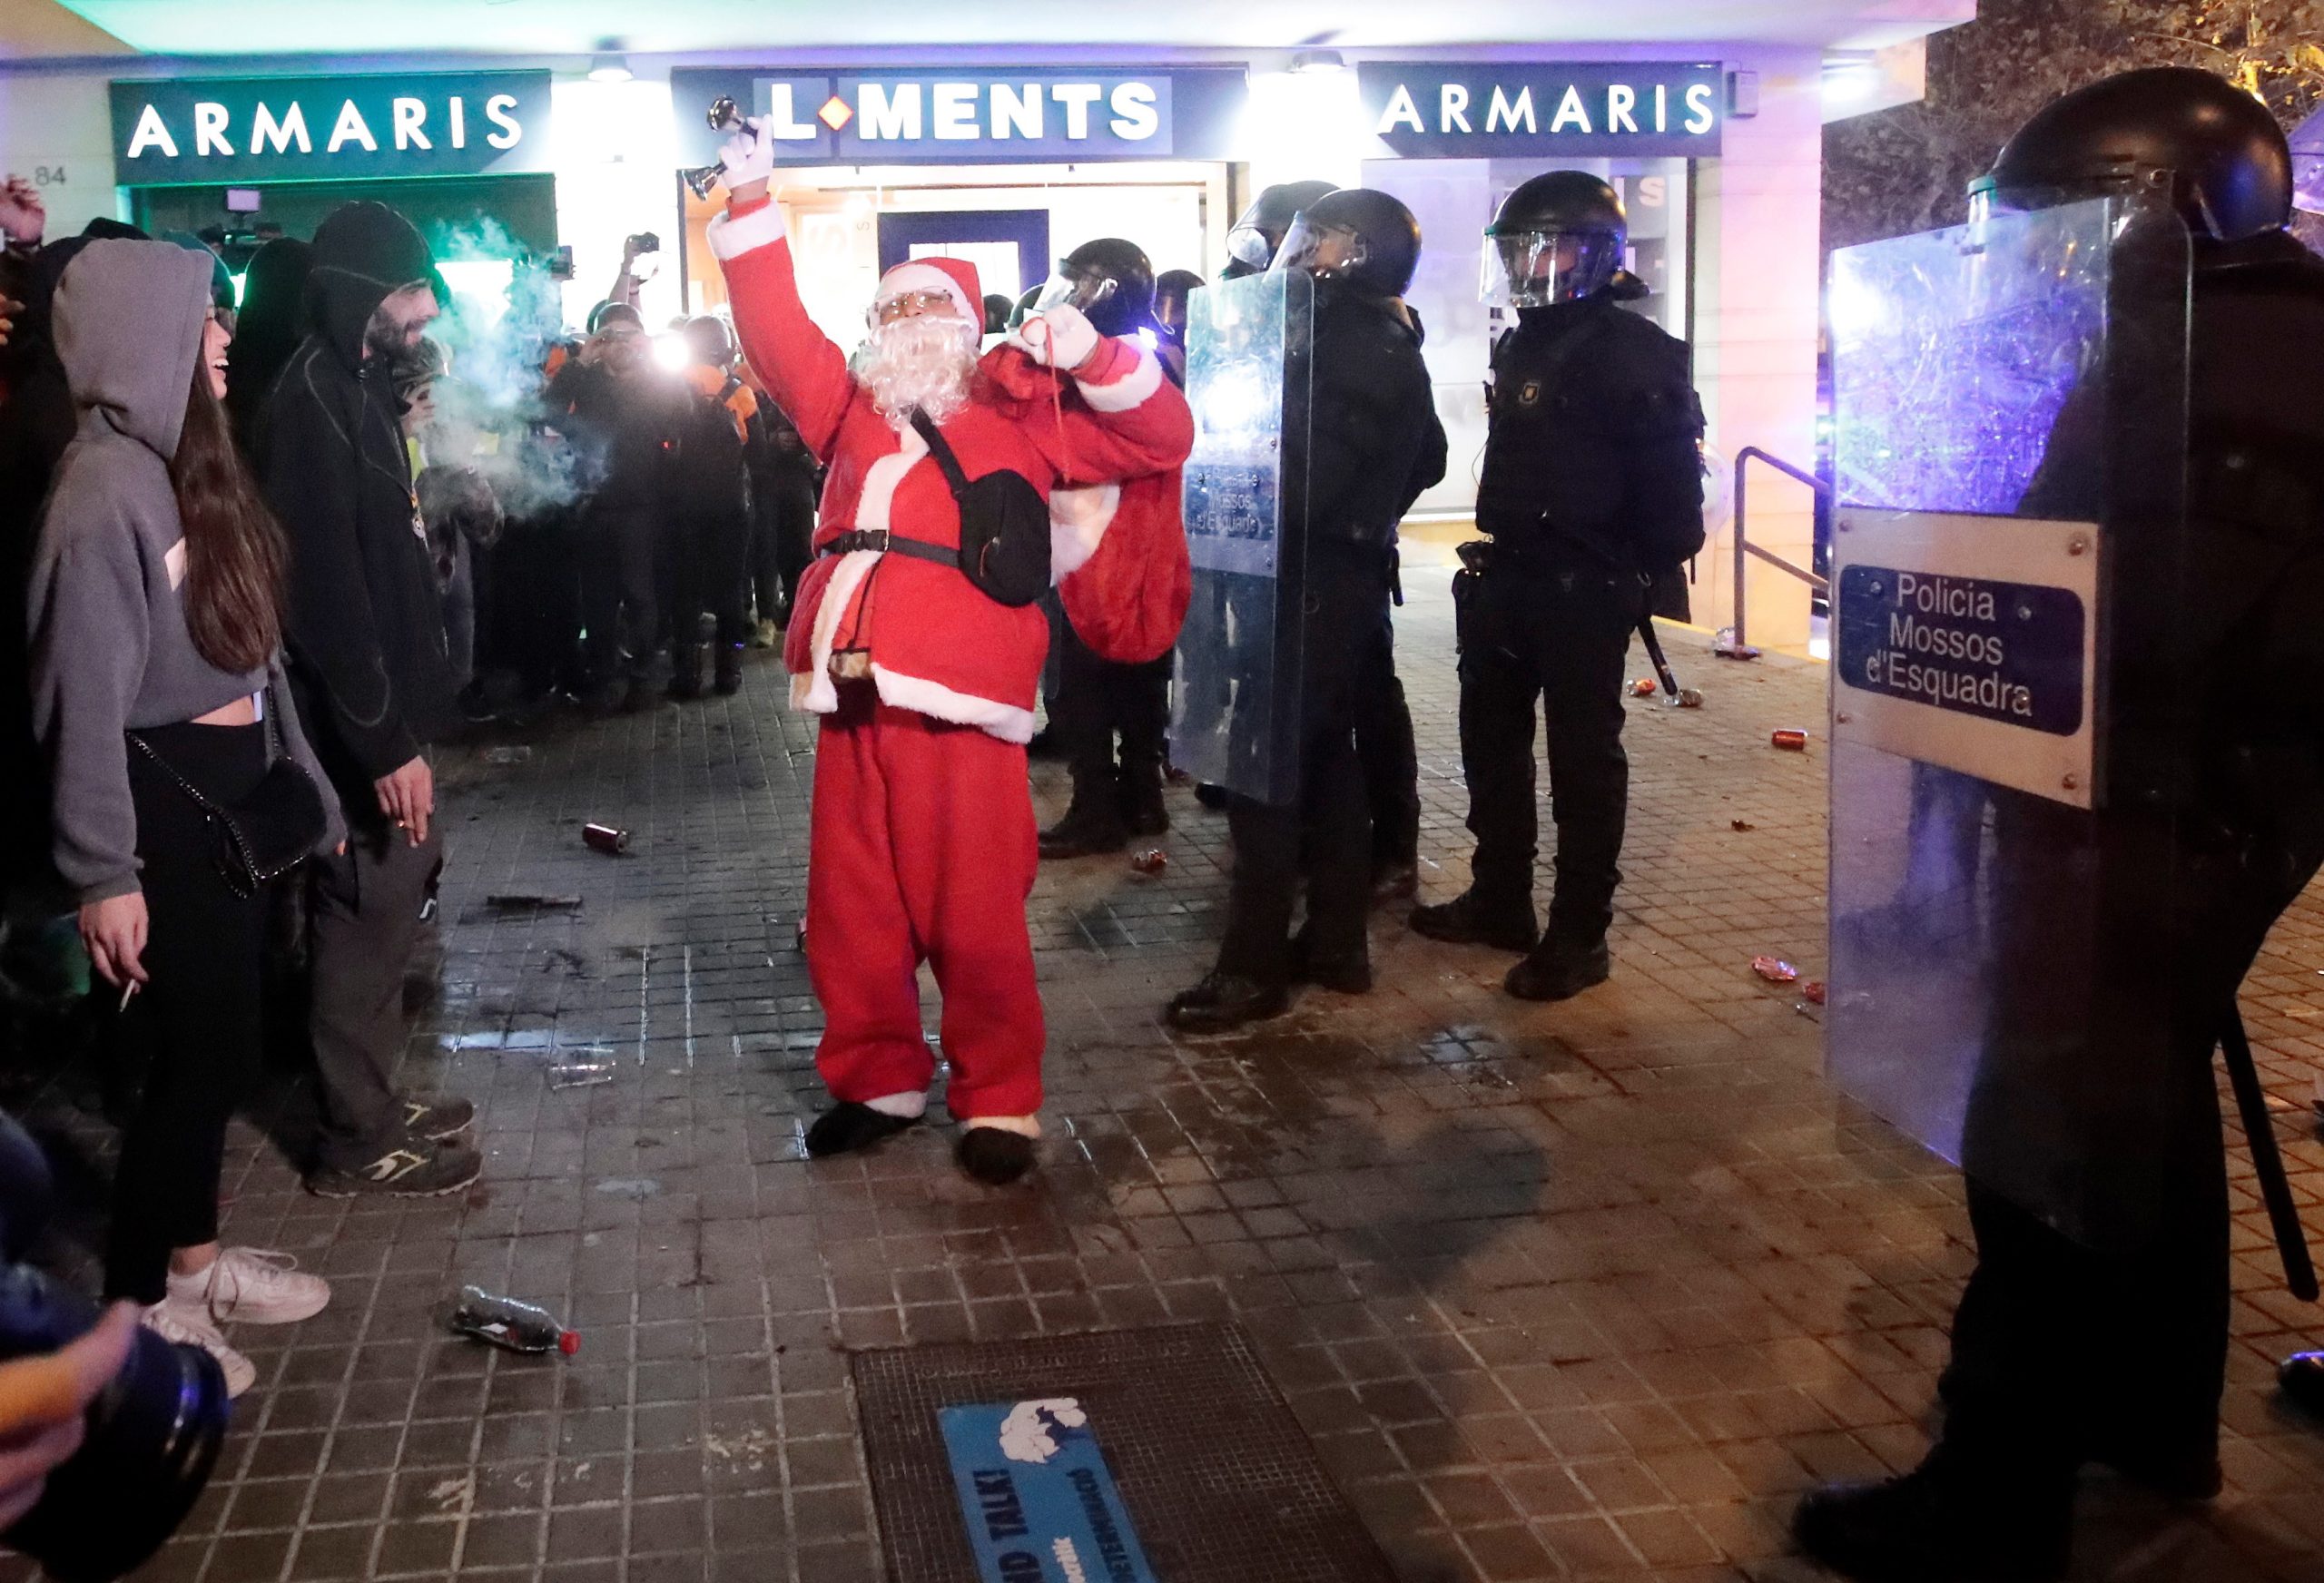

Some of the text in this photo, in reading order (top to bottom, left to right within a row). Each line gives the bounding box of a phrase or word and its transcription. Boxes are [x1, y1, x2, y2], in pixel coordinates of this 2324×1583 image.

[127, 93, 524, 158] ARMARIS
[1377, 84, 1714, 134] ARMARIS
[35, 166, 65, 186] 84
[1890, 613, 2003, 665] Mossos
[1866, 649, 2032, 716] d'Esquadra
[972, 1468, 1029, 1541] TALK!
